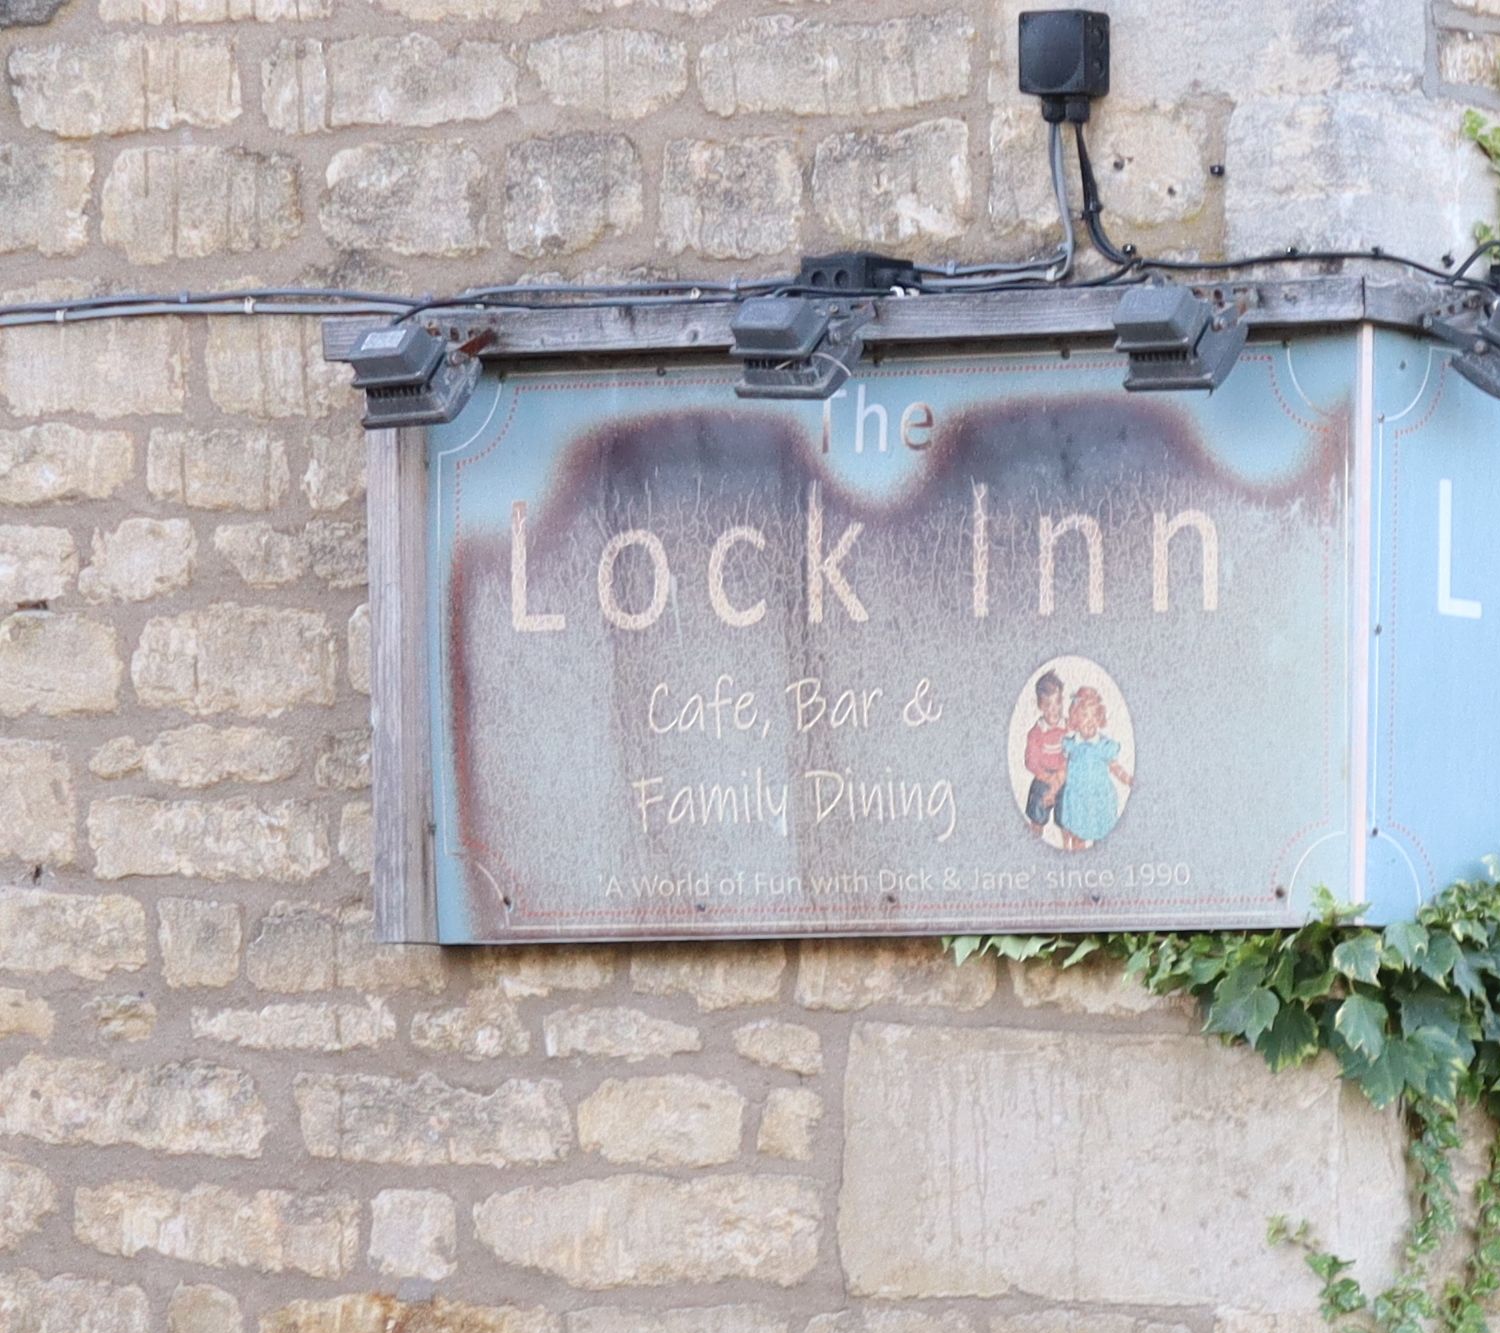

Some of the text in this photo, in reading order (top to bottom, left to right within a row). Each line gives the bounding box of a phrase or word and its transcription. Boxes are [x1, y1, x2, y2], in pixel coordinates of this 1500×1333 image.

[819, 384, 934, 454] The
[510, 484, 1219, 632] Lock Inn
[649, 674, 943, 739] Cafe, Bar &
[632, 767, 957, 842] Family Dining
[631, 871, 710, 898] World
[719, 871, 745, 896] of
[754, 873, 801, 895] Fun
[810, 870, 868, 895] with
[878, 867, 934, 892] Dick
[942, 866, 962, 891] &
[1046, 865, 1116, 889] since
[1123, 862, 1191, 889] 1990
